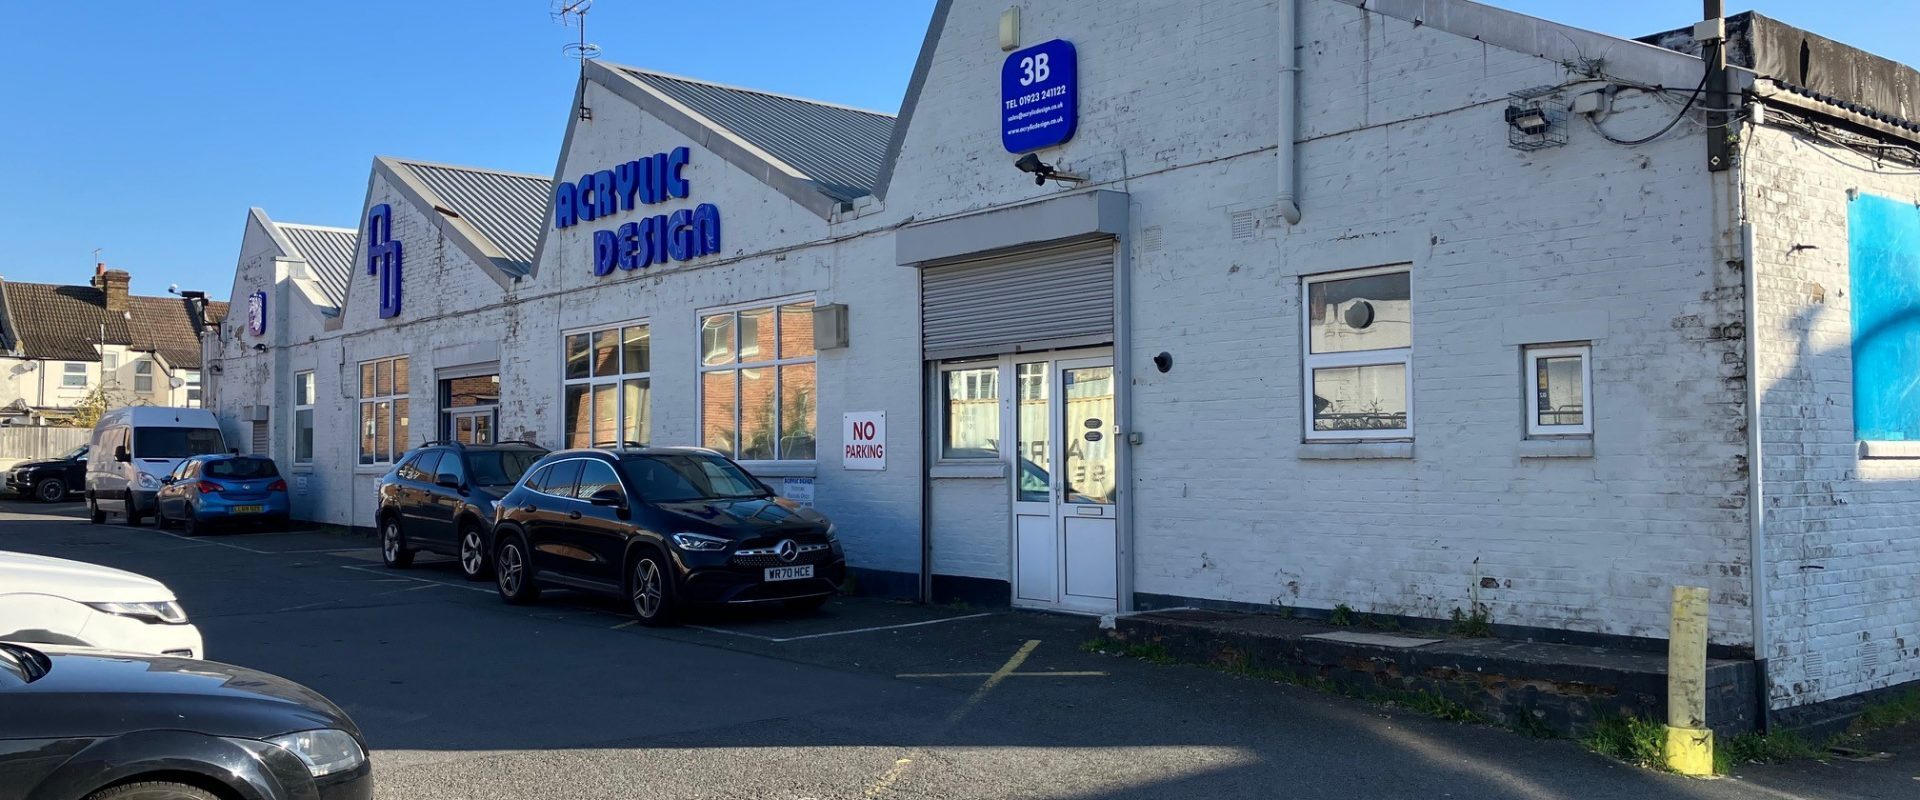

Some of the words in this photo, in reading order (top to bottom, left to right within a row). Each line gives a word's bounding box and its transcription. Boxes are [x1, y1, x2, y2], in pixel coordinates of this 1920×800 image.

[1020, 53, 1050, 86] 3B
[1005, 99, 1018, 110] TEL
[1019, 92, 1040, 106] 01923
[1041, 85, 1066, 99] 241122
[1007, 116, 1063, 135] www.acrylicdesign.co.uk
[555, 146, 690, 229] ACRYLIC
[593, 203, 721, 277] DESIGN
[853, 421, 875, 440] NO
[846, 444, 883, 458] PARKING
[769, 568, 792, 579] WR70
[794, 566, 810, 577] HCE
